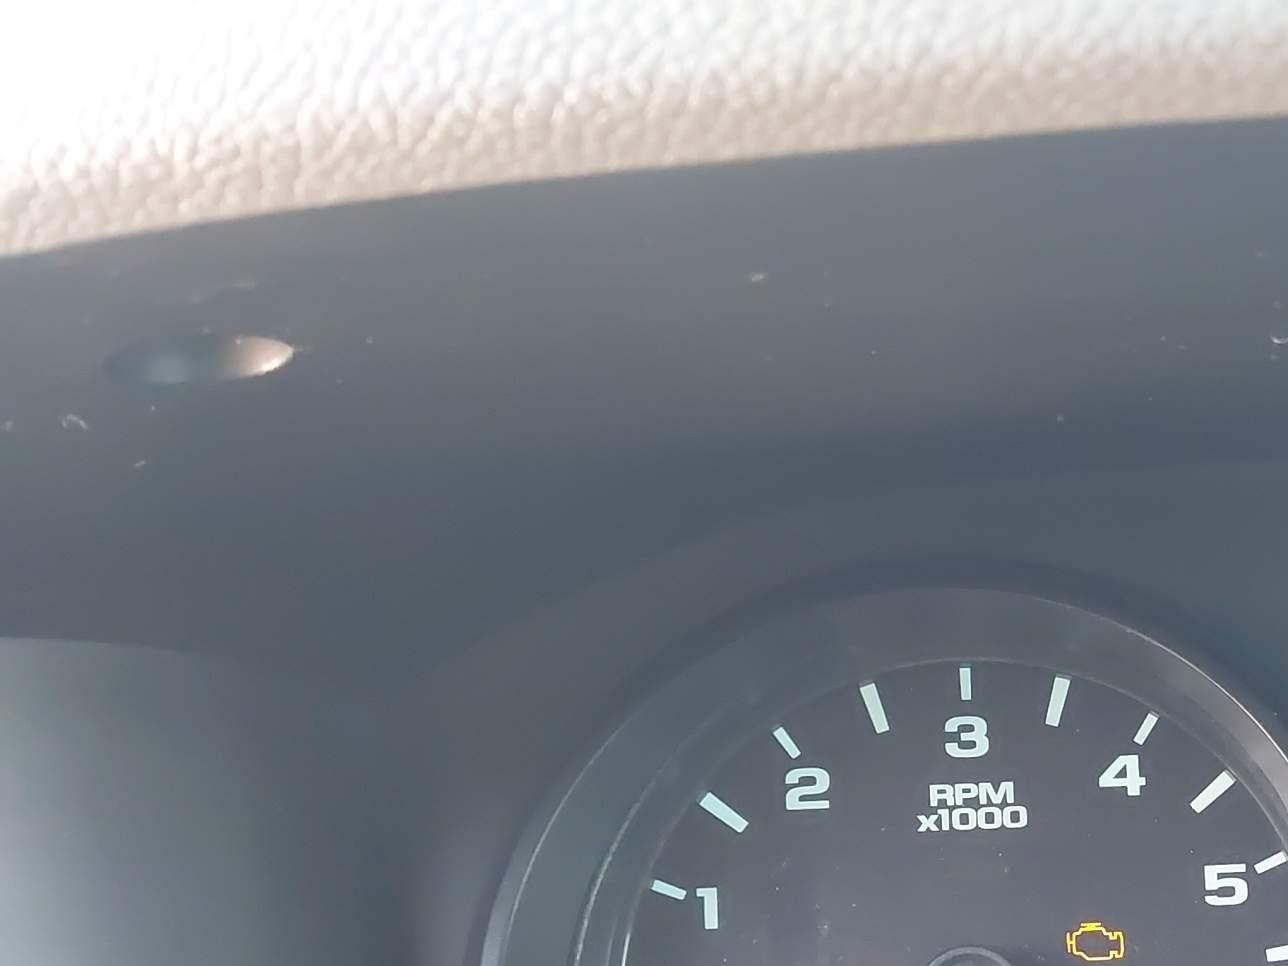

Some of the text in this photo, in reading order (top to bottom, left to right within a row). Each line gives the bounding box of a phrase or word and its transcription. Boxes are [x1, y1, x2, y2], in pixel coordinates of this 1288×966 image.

[944, 715, 990, 759] 3
[784, 767, 831, 811] 2
[928, 781, 1015, 806] RPM
[1099, 754, 1147, 797] 4
[916, 805, 1029, 833] x1000
[1203, 864, 1249, 906] 5
[696, 887, 719, 930] 1
